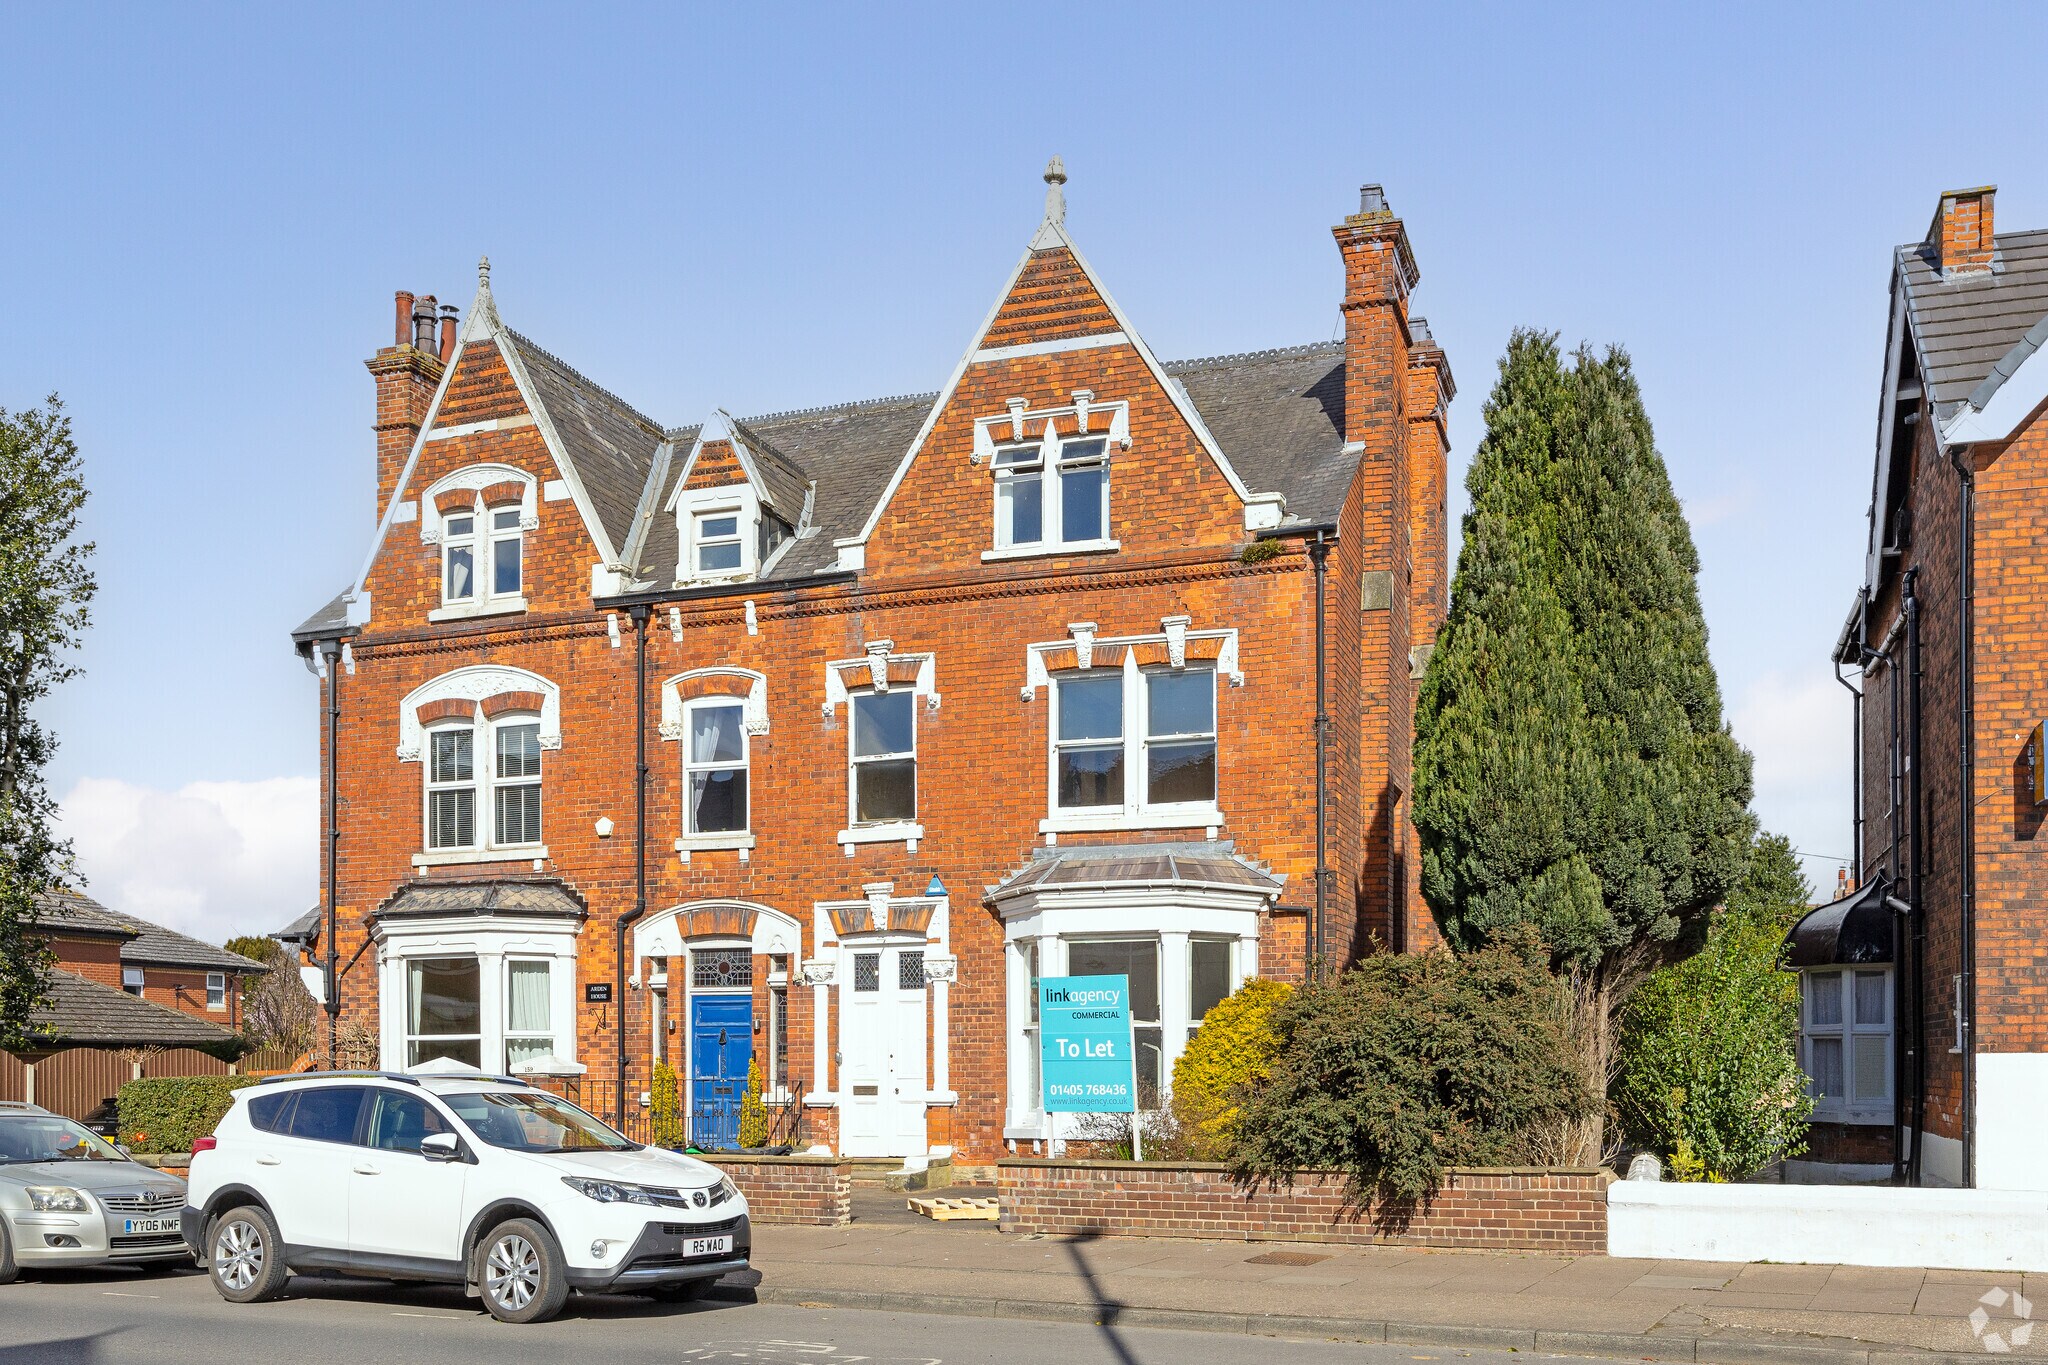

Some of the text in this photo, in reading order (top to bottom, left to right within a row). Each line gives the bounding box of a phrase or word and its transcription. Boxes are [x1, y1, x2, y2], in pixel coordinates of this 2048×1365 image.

[1046, 987, 1120, 1005] linkagency
[1072, 1011, 1120, 1020] COMMERCIAL
[1055, 1038, 1116, 1058] To Let
[1050, 1084, 1127, 1096] 01405 768436
[1050, 1097, 1128, 1107] www.linkagency.co.uk
[132, 1219, 180, 1232] YY06 NMF
[693, 1240, 705, 1253] R5
